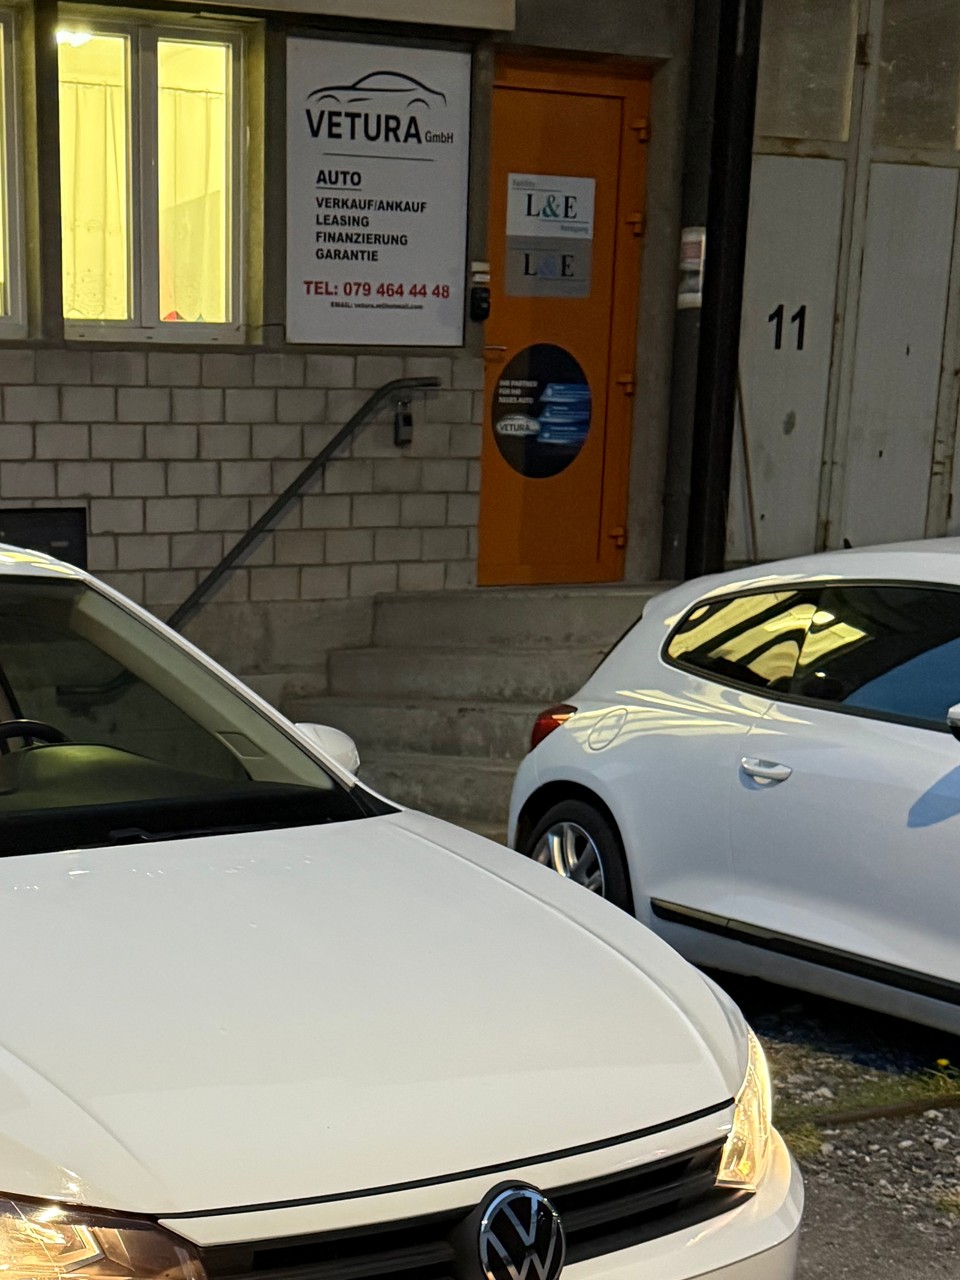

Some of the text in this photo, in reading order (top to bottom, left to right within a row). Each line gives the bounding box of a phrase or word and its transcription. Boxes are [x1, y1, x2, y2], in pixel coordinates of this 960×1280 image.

[305, 109, 454, 144] VETURA GmbH
[316, 170, 362, 187] AUTO
[316, 197, 427, 213] VERKAUF/ANKAUF
[526, 193, 578, 219] L&E
[316, 214, 370, 227] LEASING
[316, 231, 408, 246] FINANZIERUNG
[316, 248, 379, 261] GARANTIE
[303, 281, 450, 299] TEL: 079 464 44 48
[768, 303, 807, 351] 11
[499, 423, 530, 432] VETURA
